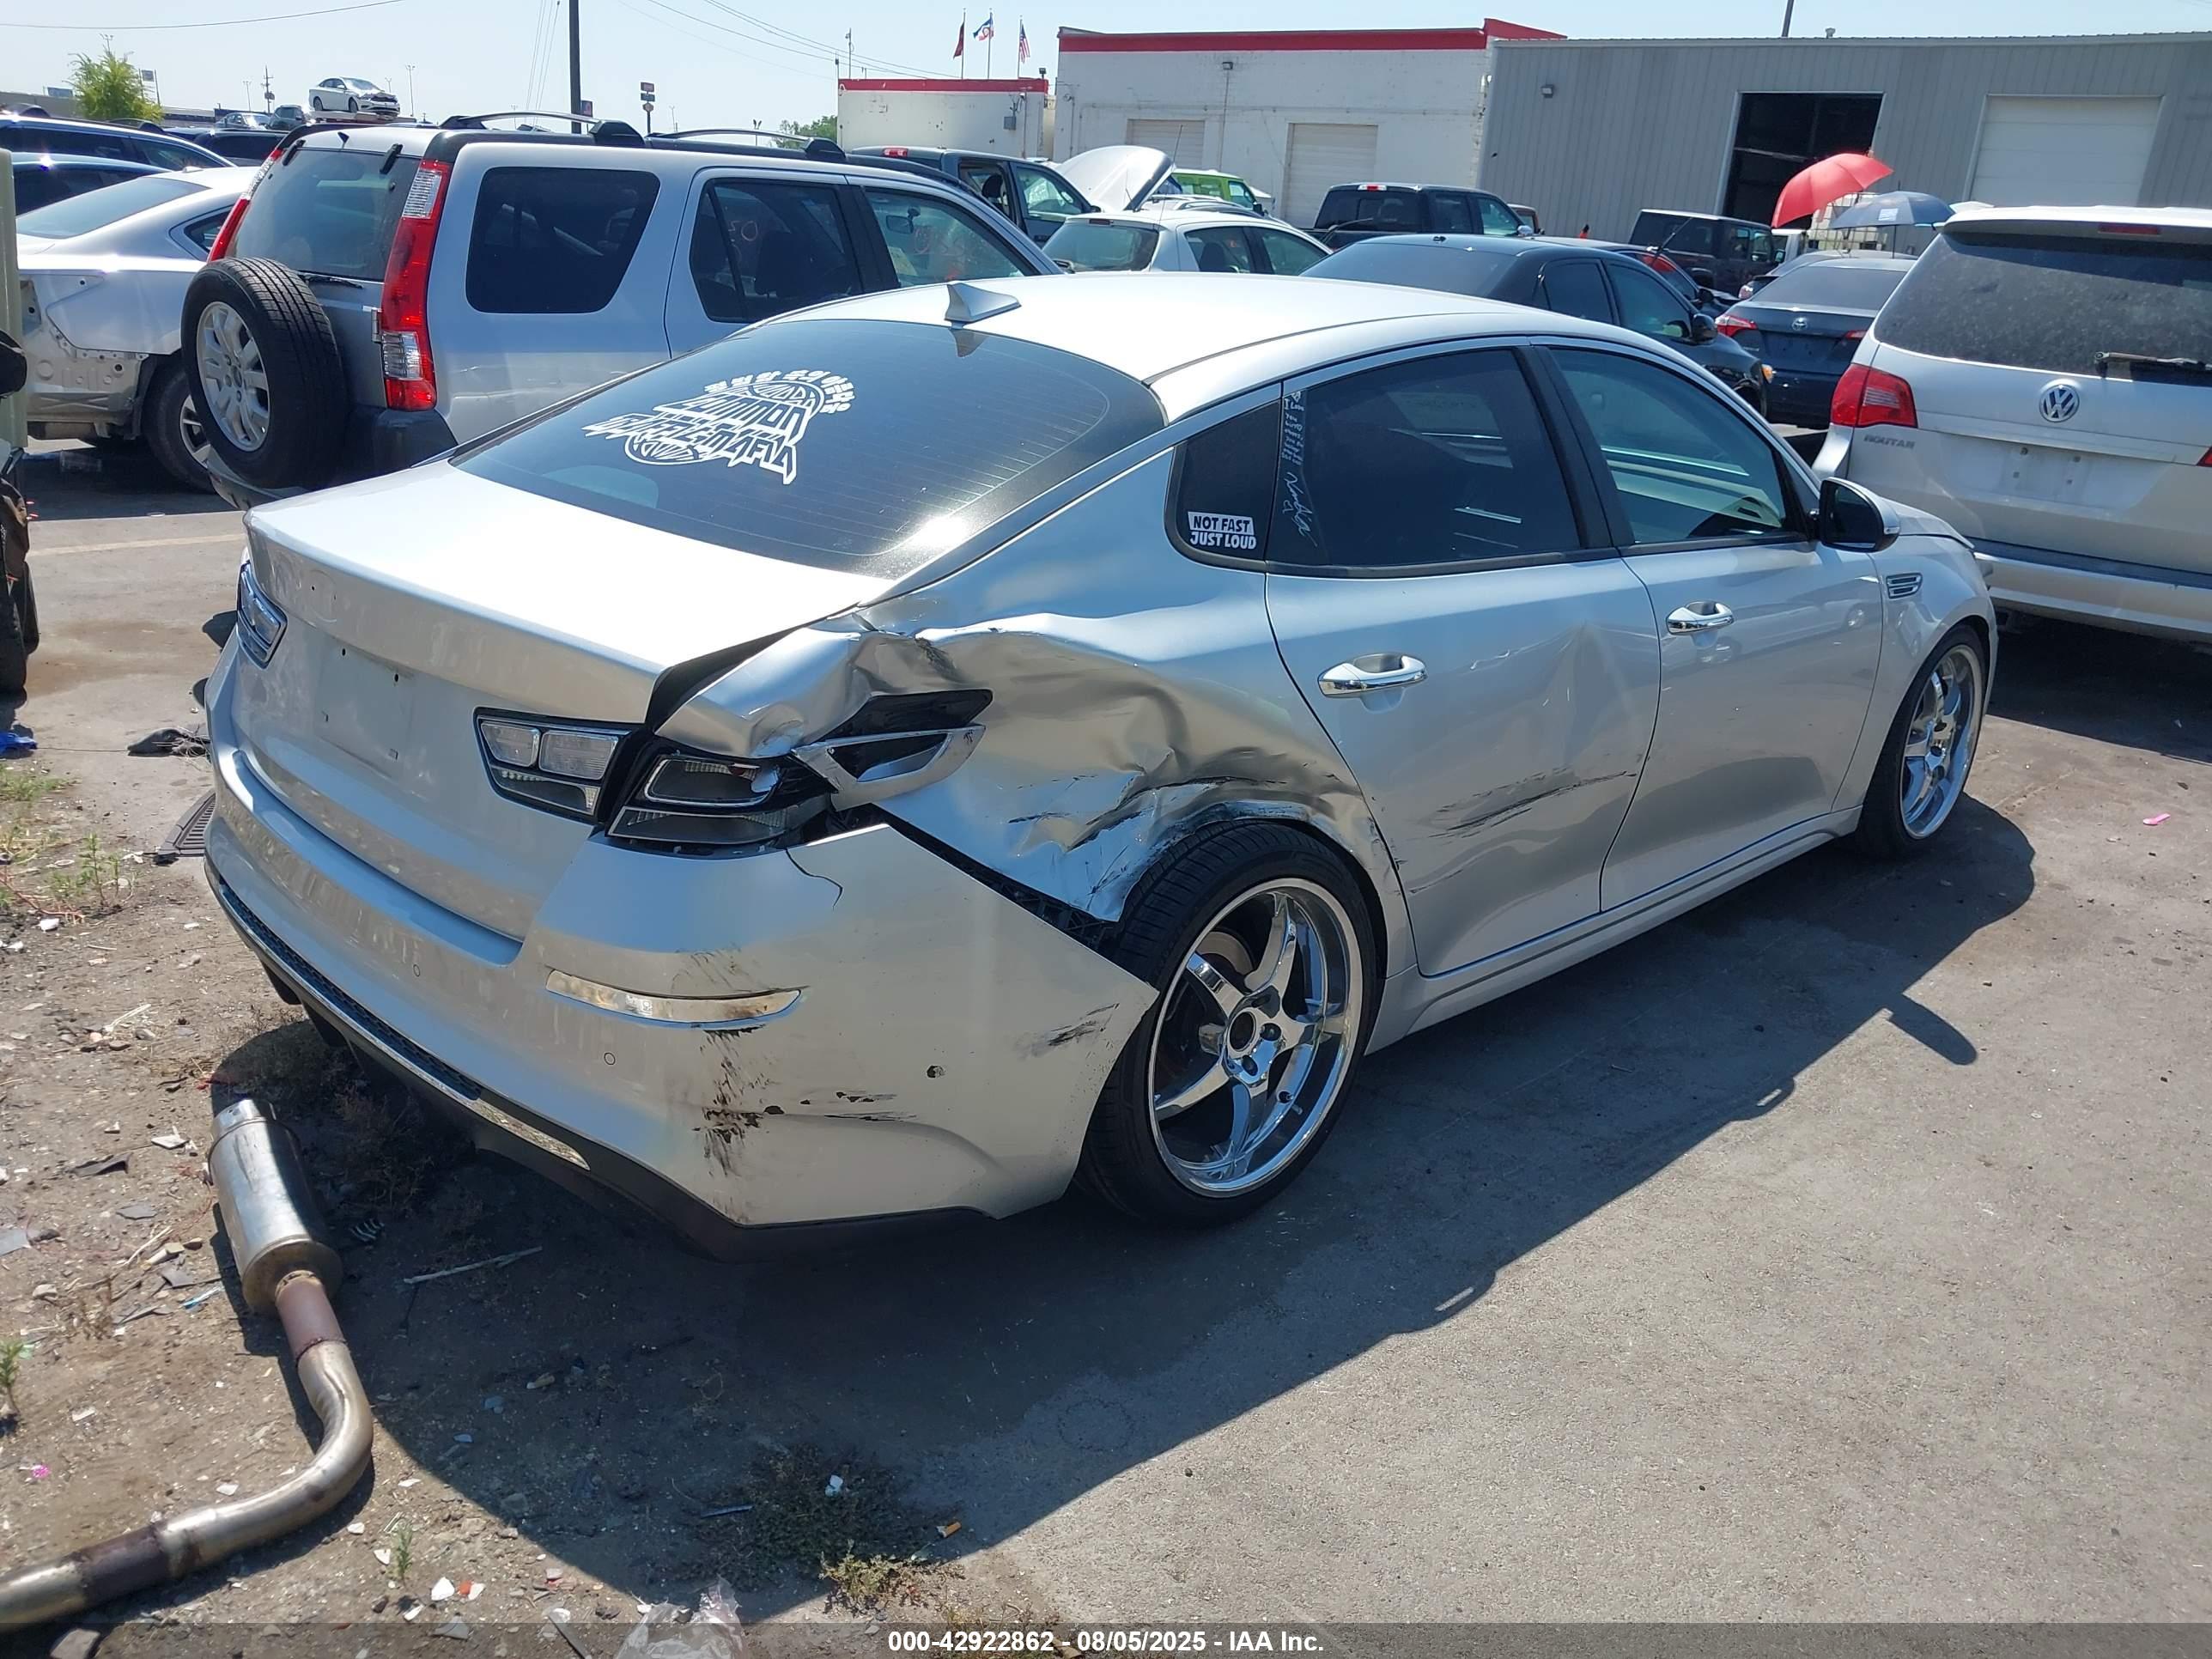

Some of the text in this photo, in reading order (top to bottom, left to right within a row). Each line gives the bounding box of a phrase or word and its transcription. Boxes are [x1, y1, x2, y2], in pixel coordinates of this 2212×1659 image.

[1193, 515, 1250, 532] NOT FAST
[1190, 531, 1256, 550] JUST LOUD
